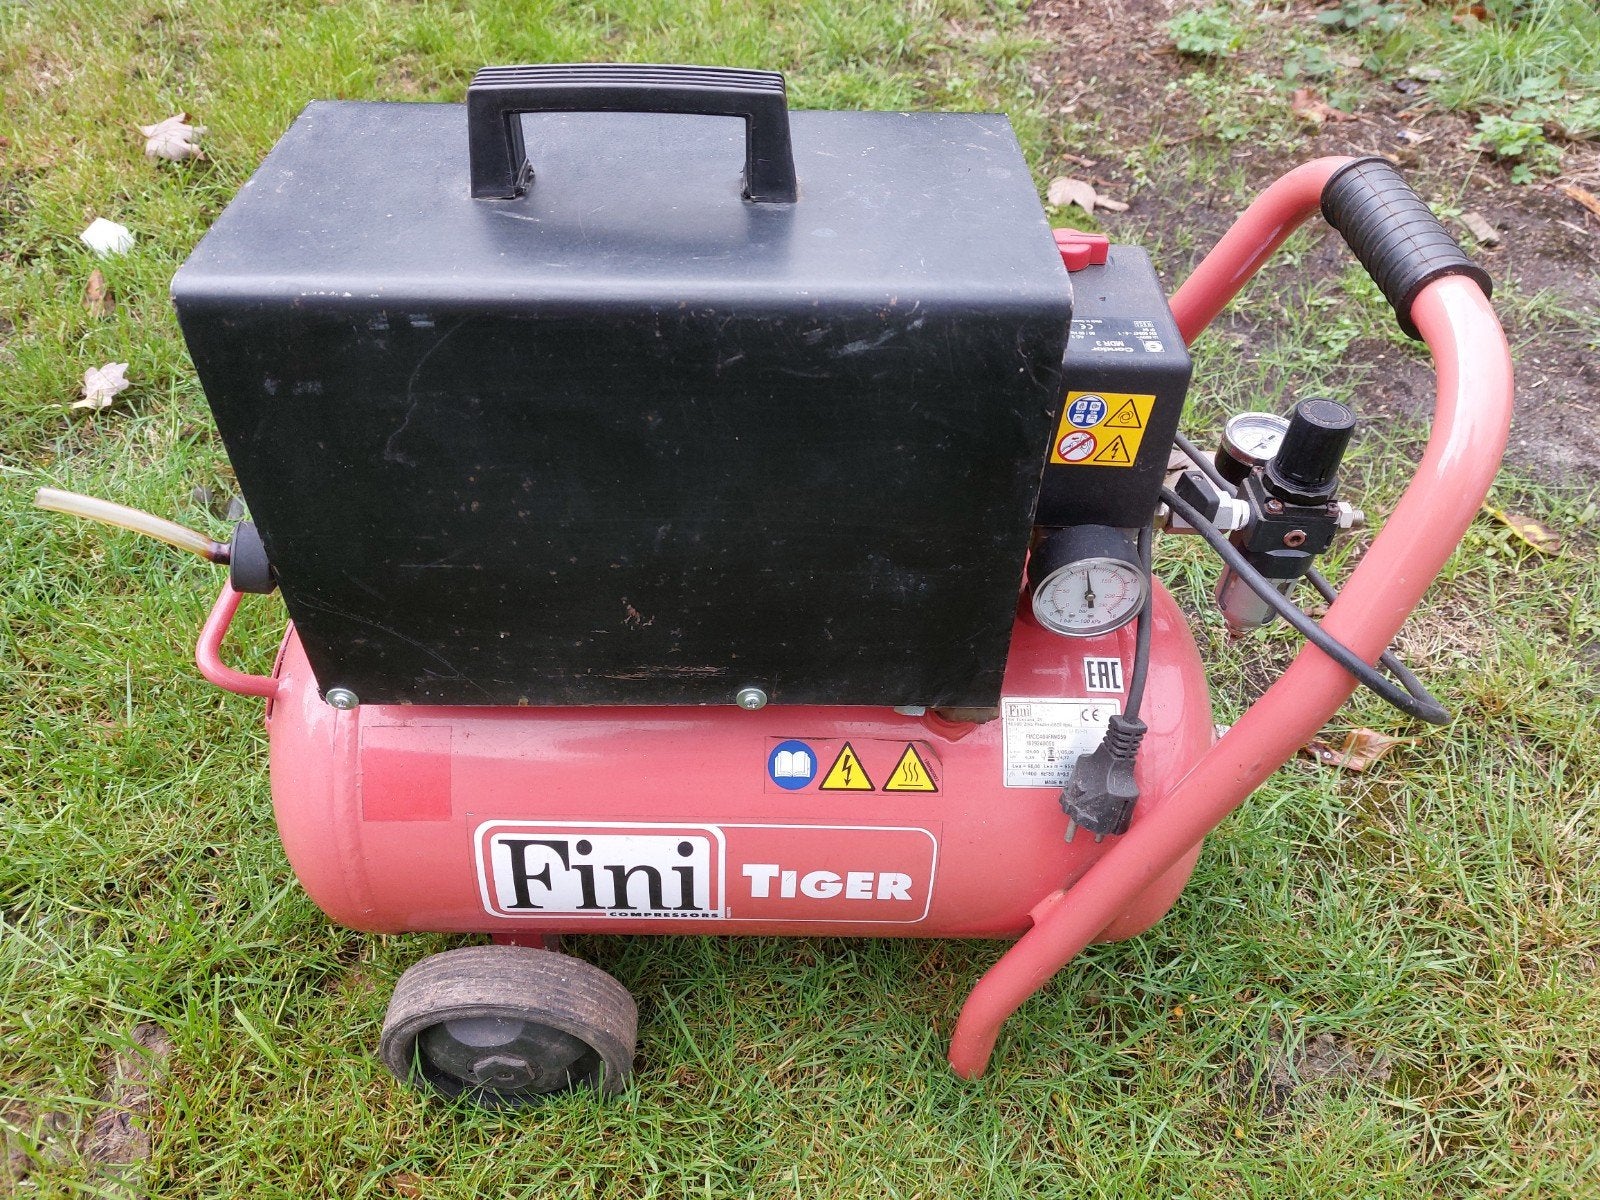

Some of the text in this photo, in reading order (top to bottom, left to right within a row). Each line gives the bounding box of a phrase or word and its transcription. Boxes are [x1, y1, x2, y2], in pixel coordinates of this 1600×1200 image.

[1087, 661, 1121, 688] EAC
[1009, 704, 1030, 717] Fini
[498, 840, 703, 910] Fini
[742, 864, 912, 900] TIGER
